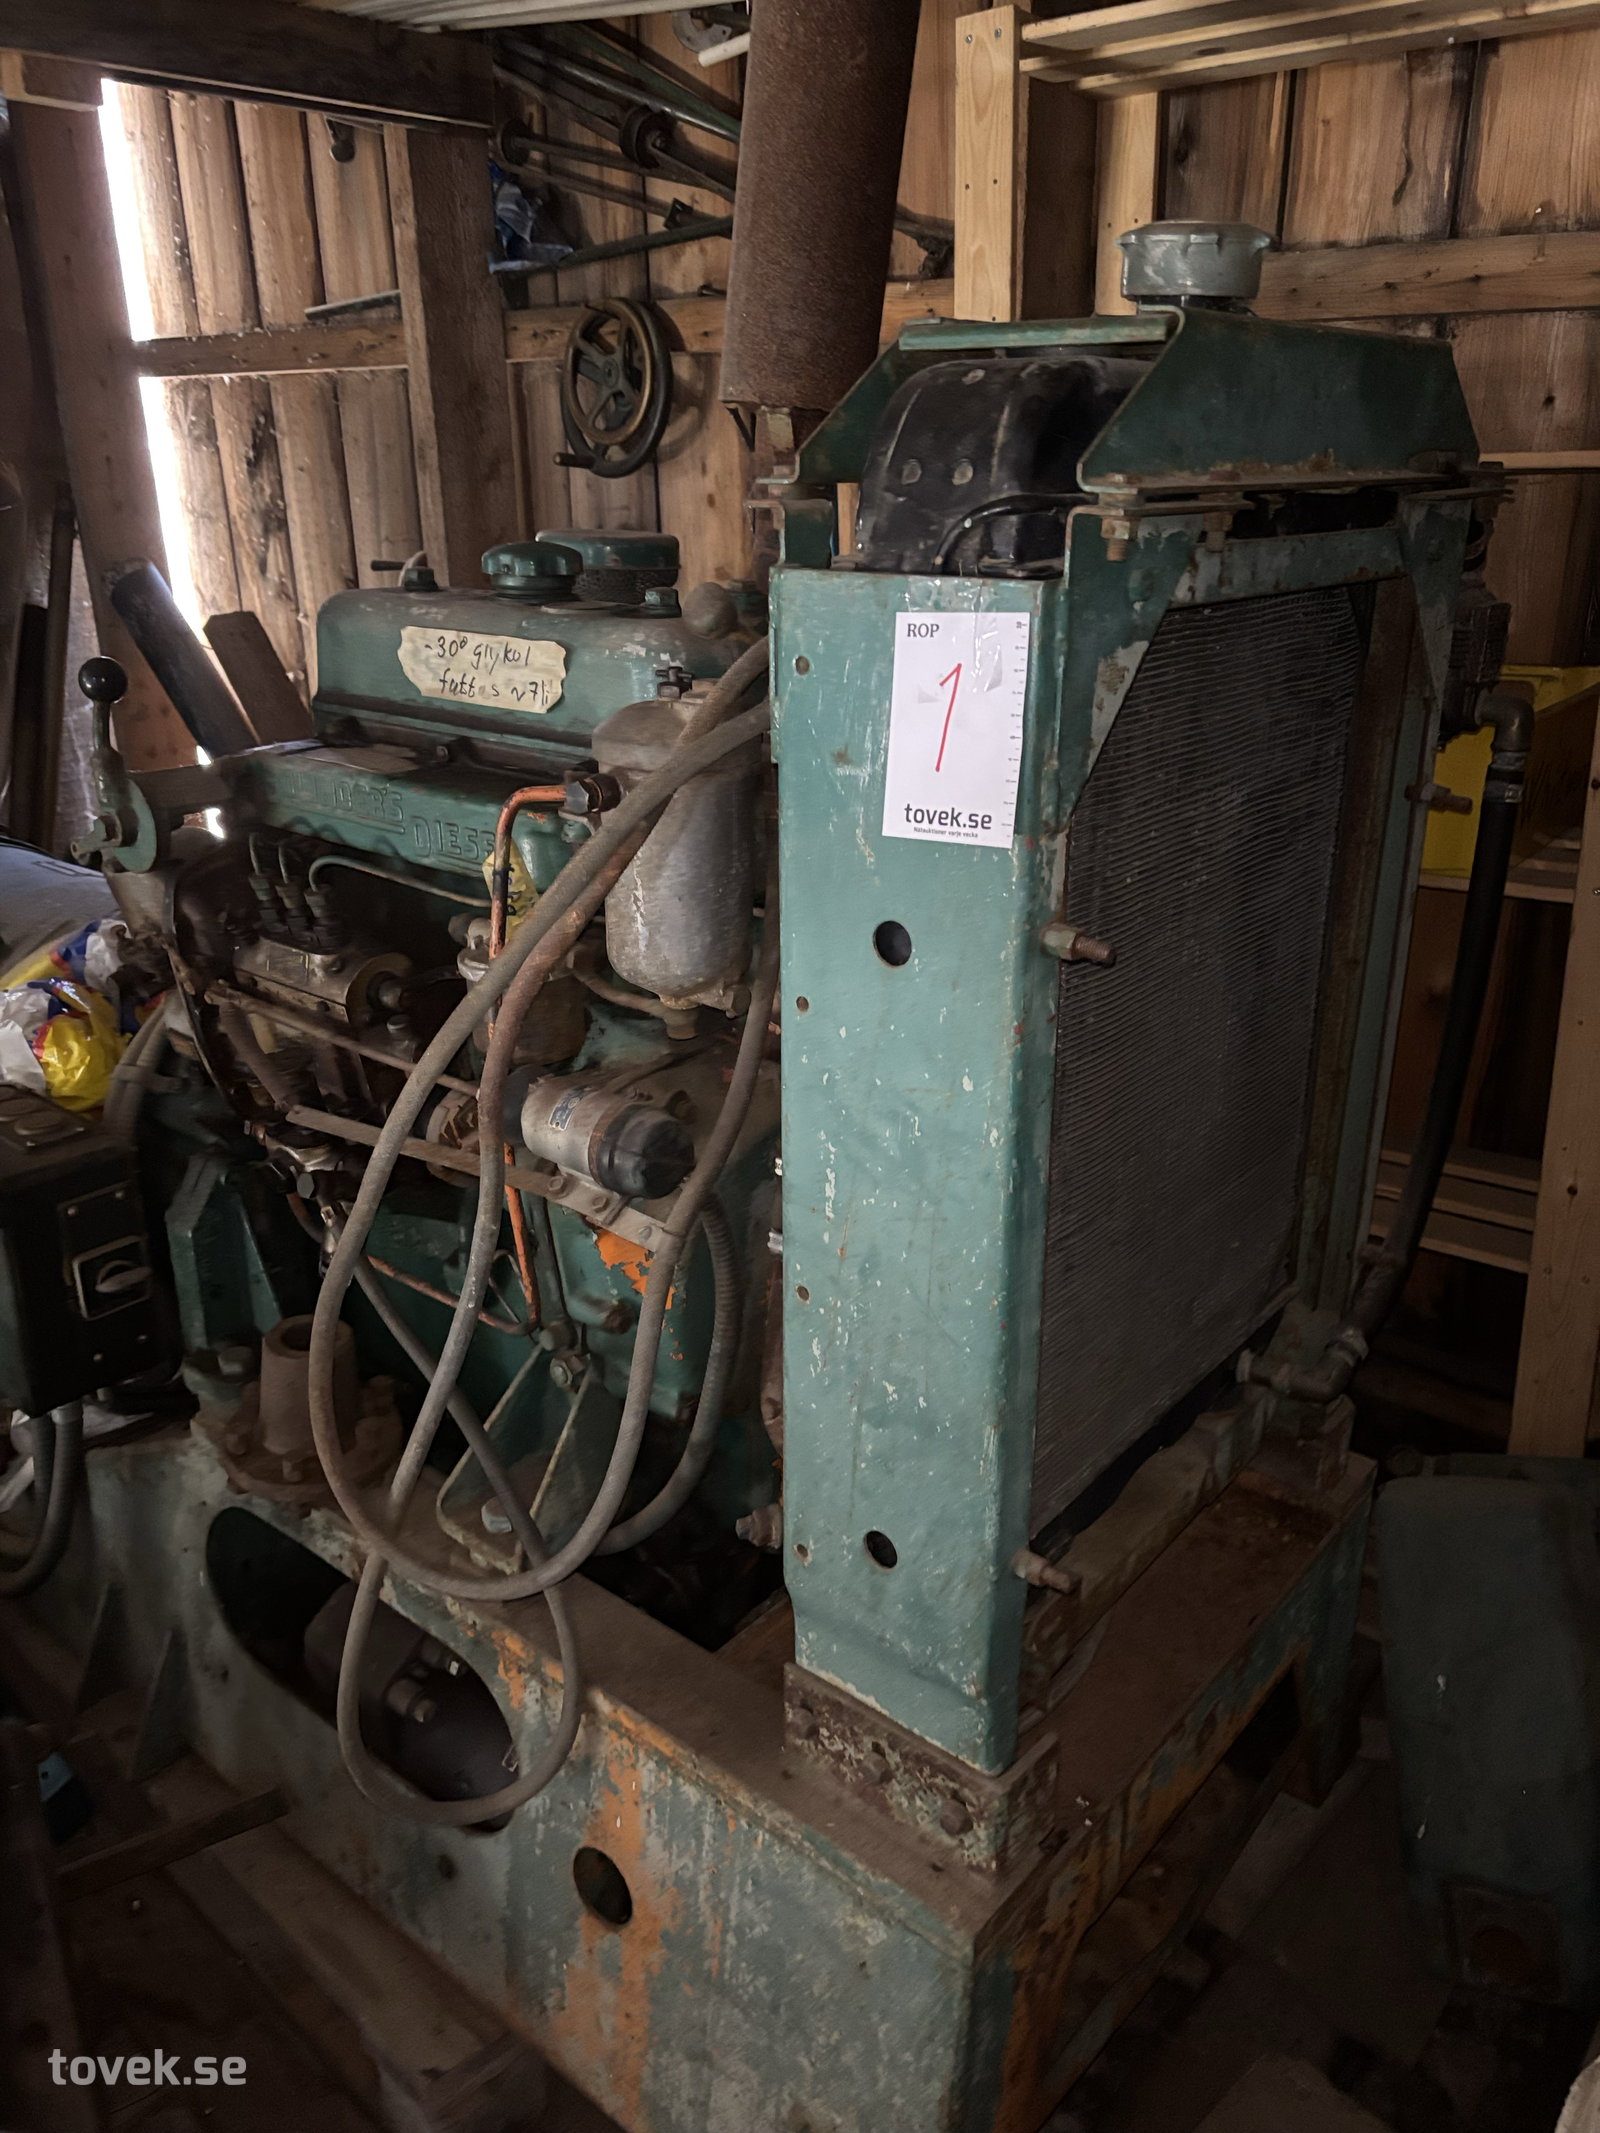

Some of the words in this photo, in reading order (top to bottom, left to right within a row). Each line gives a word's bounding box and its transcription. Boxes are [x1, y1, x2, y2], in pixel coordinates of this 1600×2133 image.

[906, 623, 940, 638] ROP
[936, 662, 963, 773] 1
[904, 803, 993, 830] tovek.se
